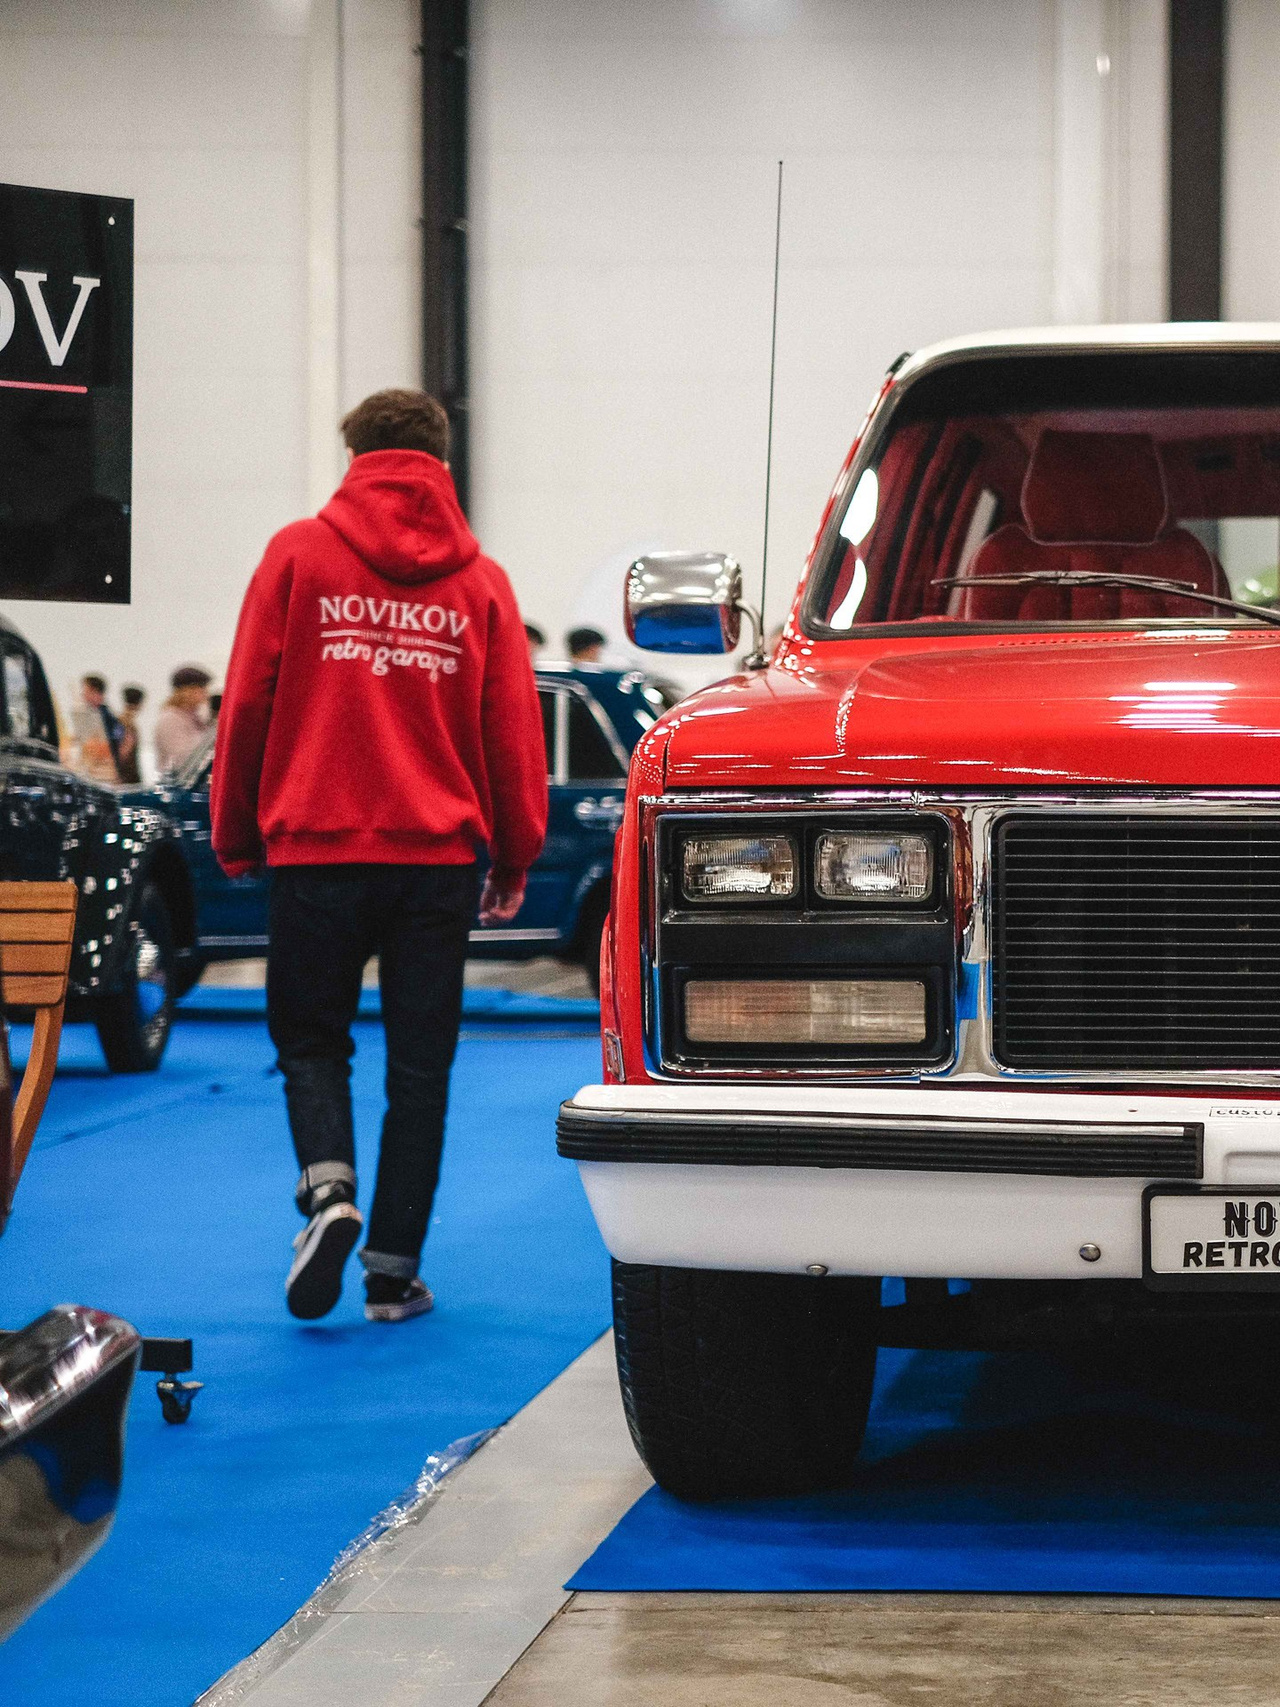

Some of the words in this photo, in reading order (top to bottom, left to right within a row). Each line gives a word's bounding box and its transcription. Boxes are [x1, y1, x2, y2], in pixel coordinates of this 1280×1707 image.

[0, 270, 101, 367] V
[318, 594, 470, 638] NOVIKOV
[322, 637, 372, 662] retro
[371, 646, 458, 684] garage
